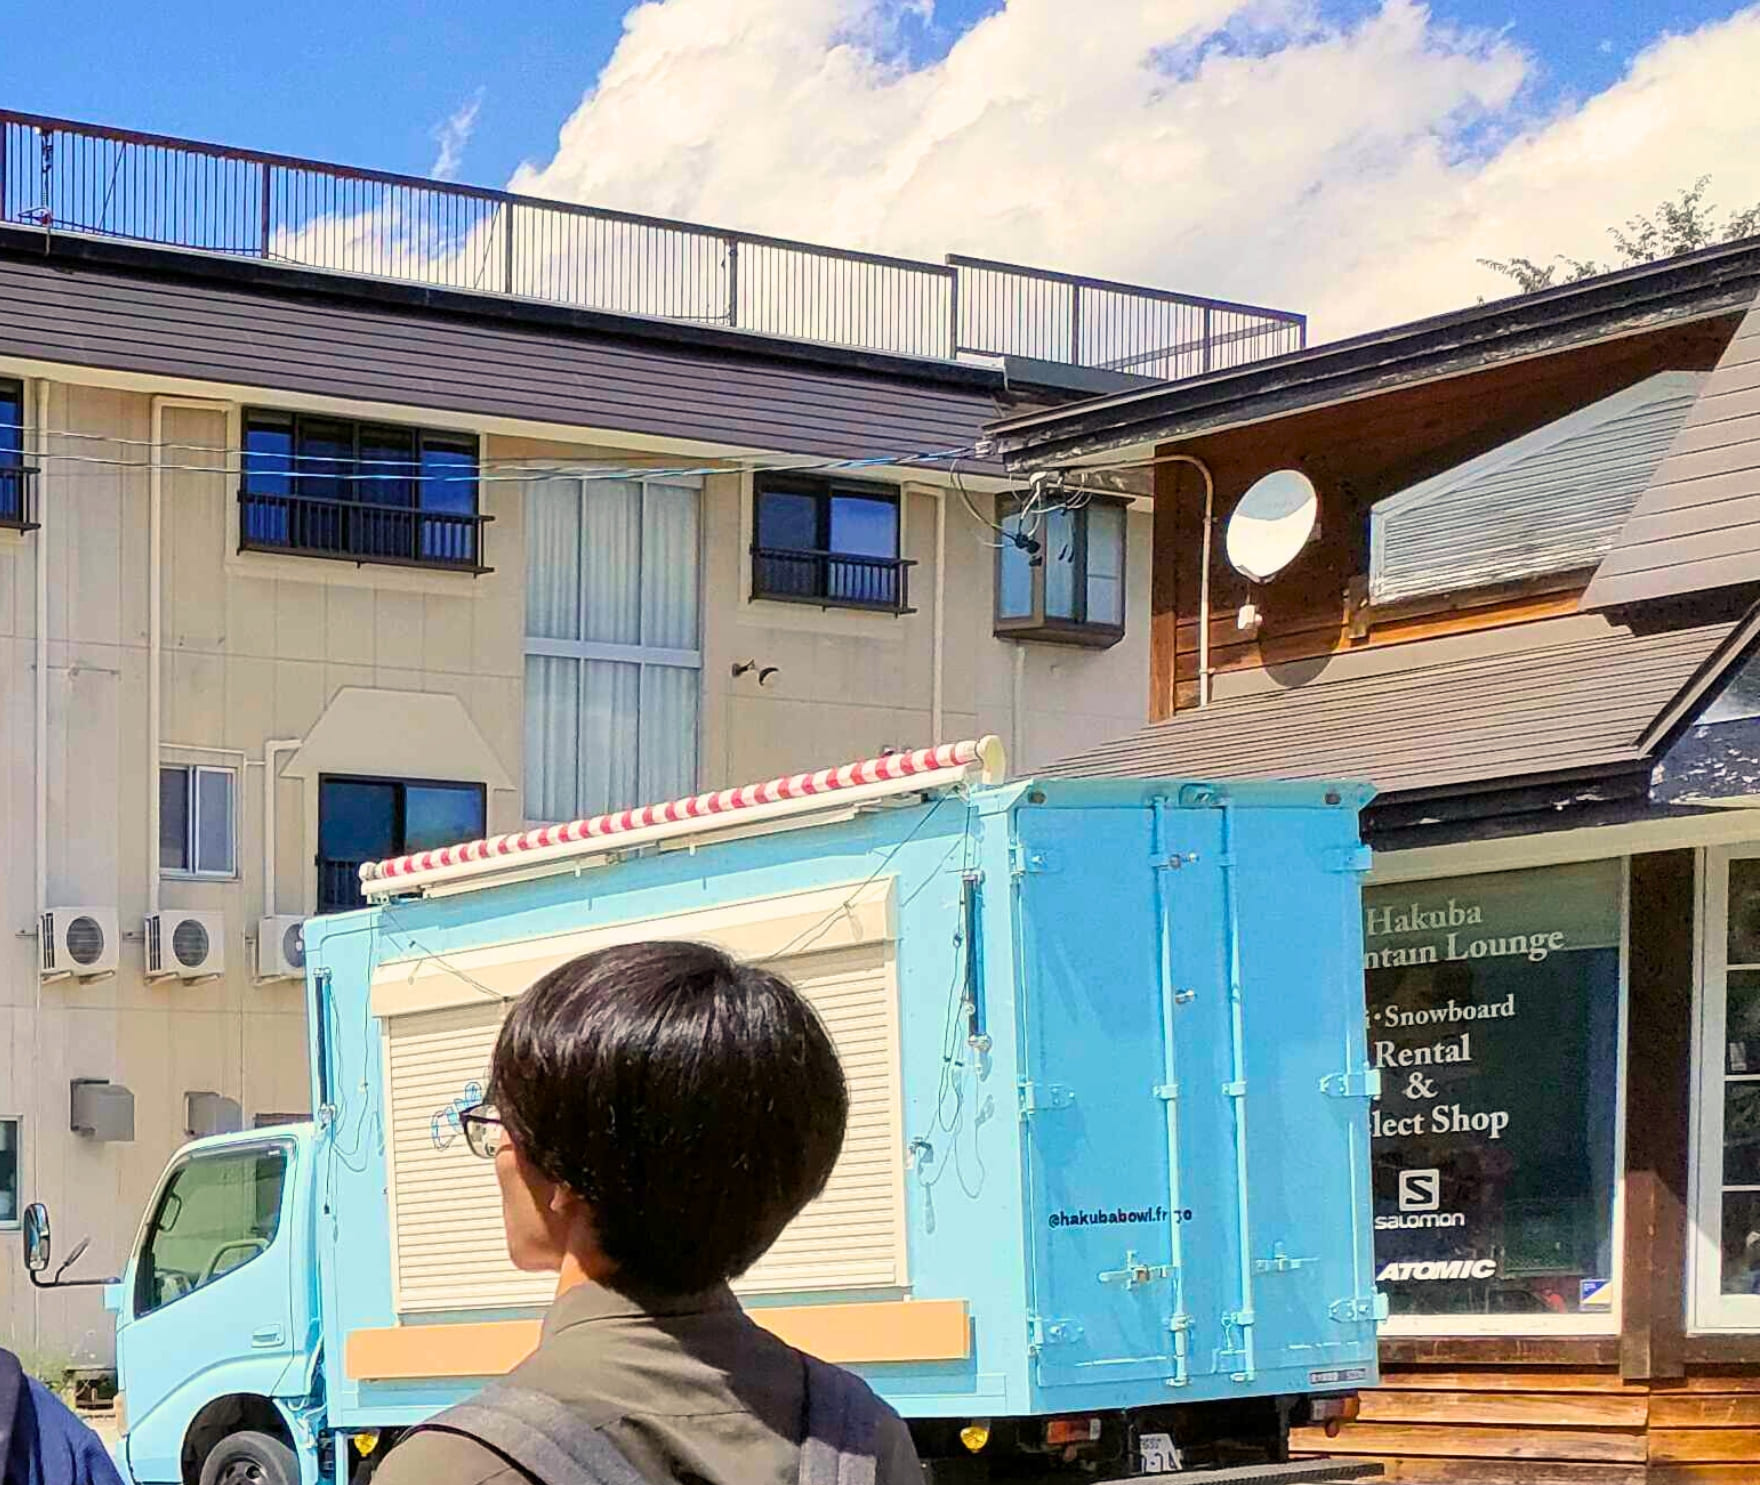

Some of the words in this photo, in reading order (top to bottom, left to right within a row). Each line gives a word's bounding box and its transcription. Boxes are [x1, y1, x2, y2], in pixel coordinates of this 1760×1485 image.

[1367, 899, 1483, 936] Hakuba
[1364, 945, 1439, 970] ntain
[1445, 931, 1565, 962] Lounge
[1374, 1033, 1473, 1068] Rental
[1402, 1071, 1439, 1100] &
[1371, 1110, 1426, 1138] lect
[1431, 1104, 1509, 1139] Shop
[1376, 1259, 1497, 1281] ATOMIC
